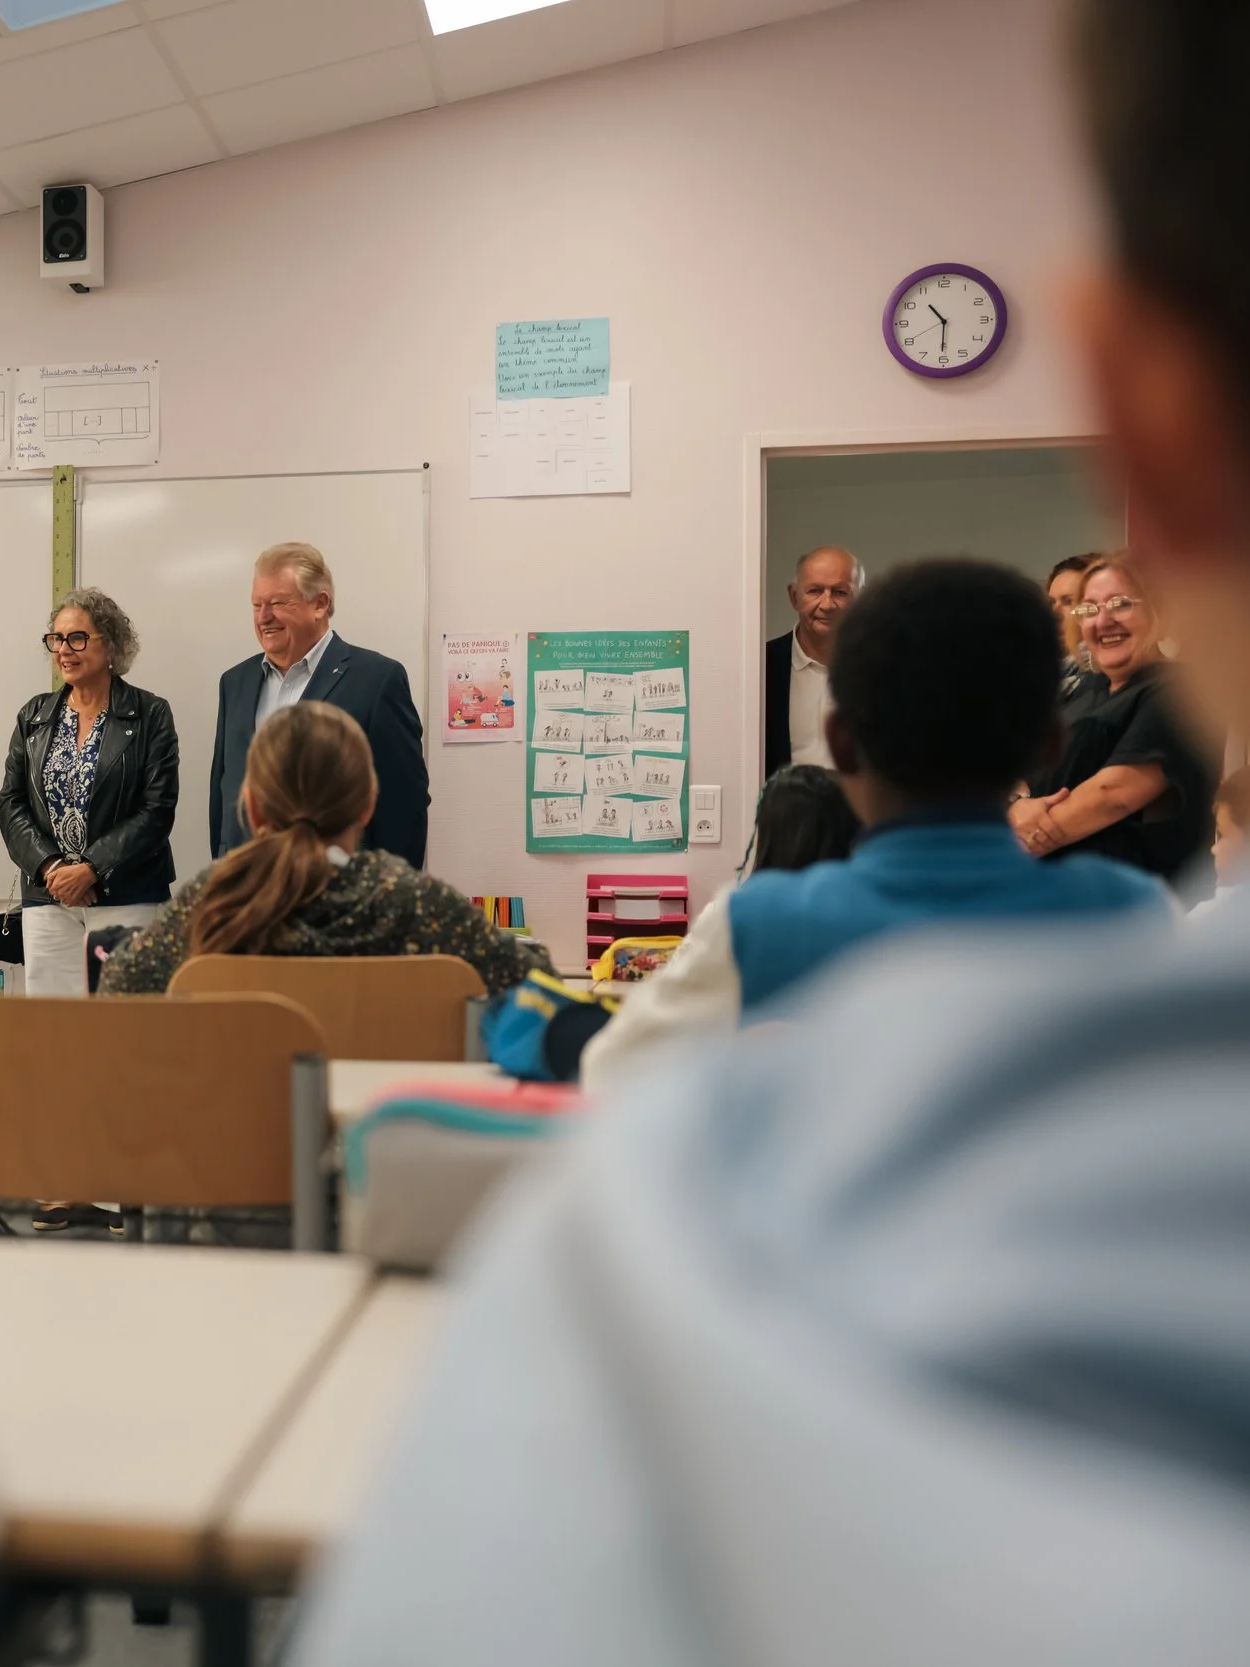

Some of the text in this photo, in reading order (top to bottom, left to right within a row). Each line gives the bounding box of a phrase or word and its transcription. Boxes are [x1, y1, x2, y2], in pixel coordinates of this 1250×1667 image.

[938, 280, 950, 288] 12
[919, 287, 927, 295] 11
[904, 302, 916, 310] 10
[974, 298, 984, 306] 2
[899, 320, 909, 328] 9
[979, 316, 989, 324] 3
[904, 338, 915, 346] 8
[958, 350, 968, 358] 5
[938, 356, 949, 364] 6
[565, 639, 593, 648] BONNES
[618, 639, 630, 648] DES
[634, 638, 668, 648] ENFANTS
[552, 649, 664, 660] POUR BIEN VIVRE ENSEMBLE
